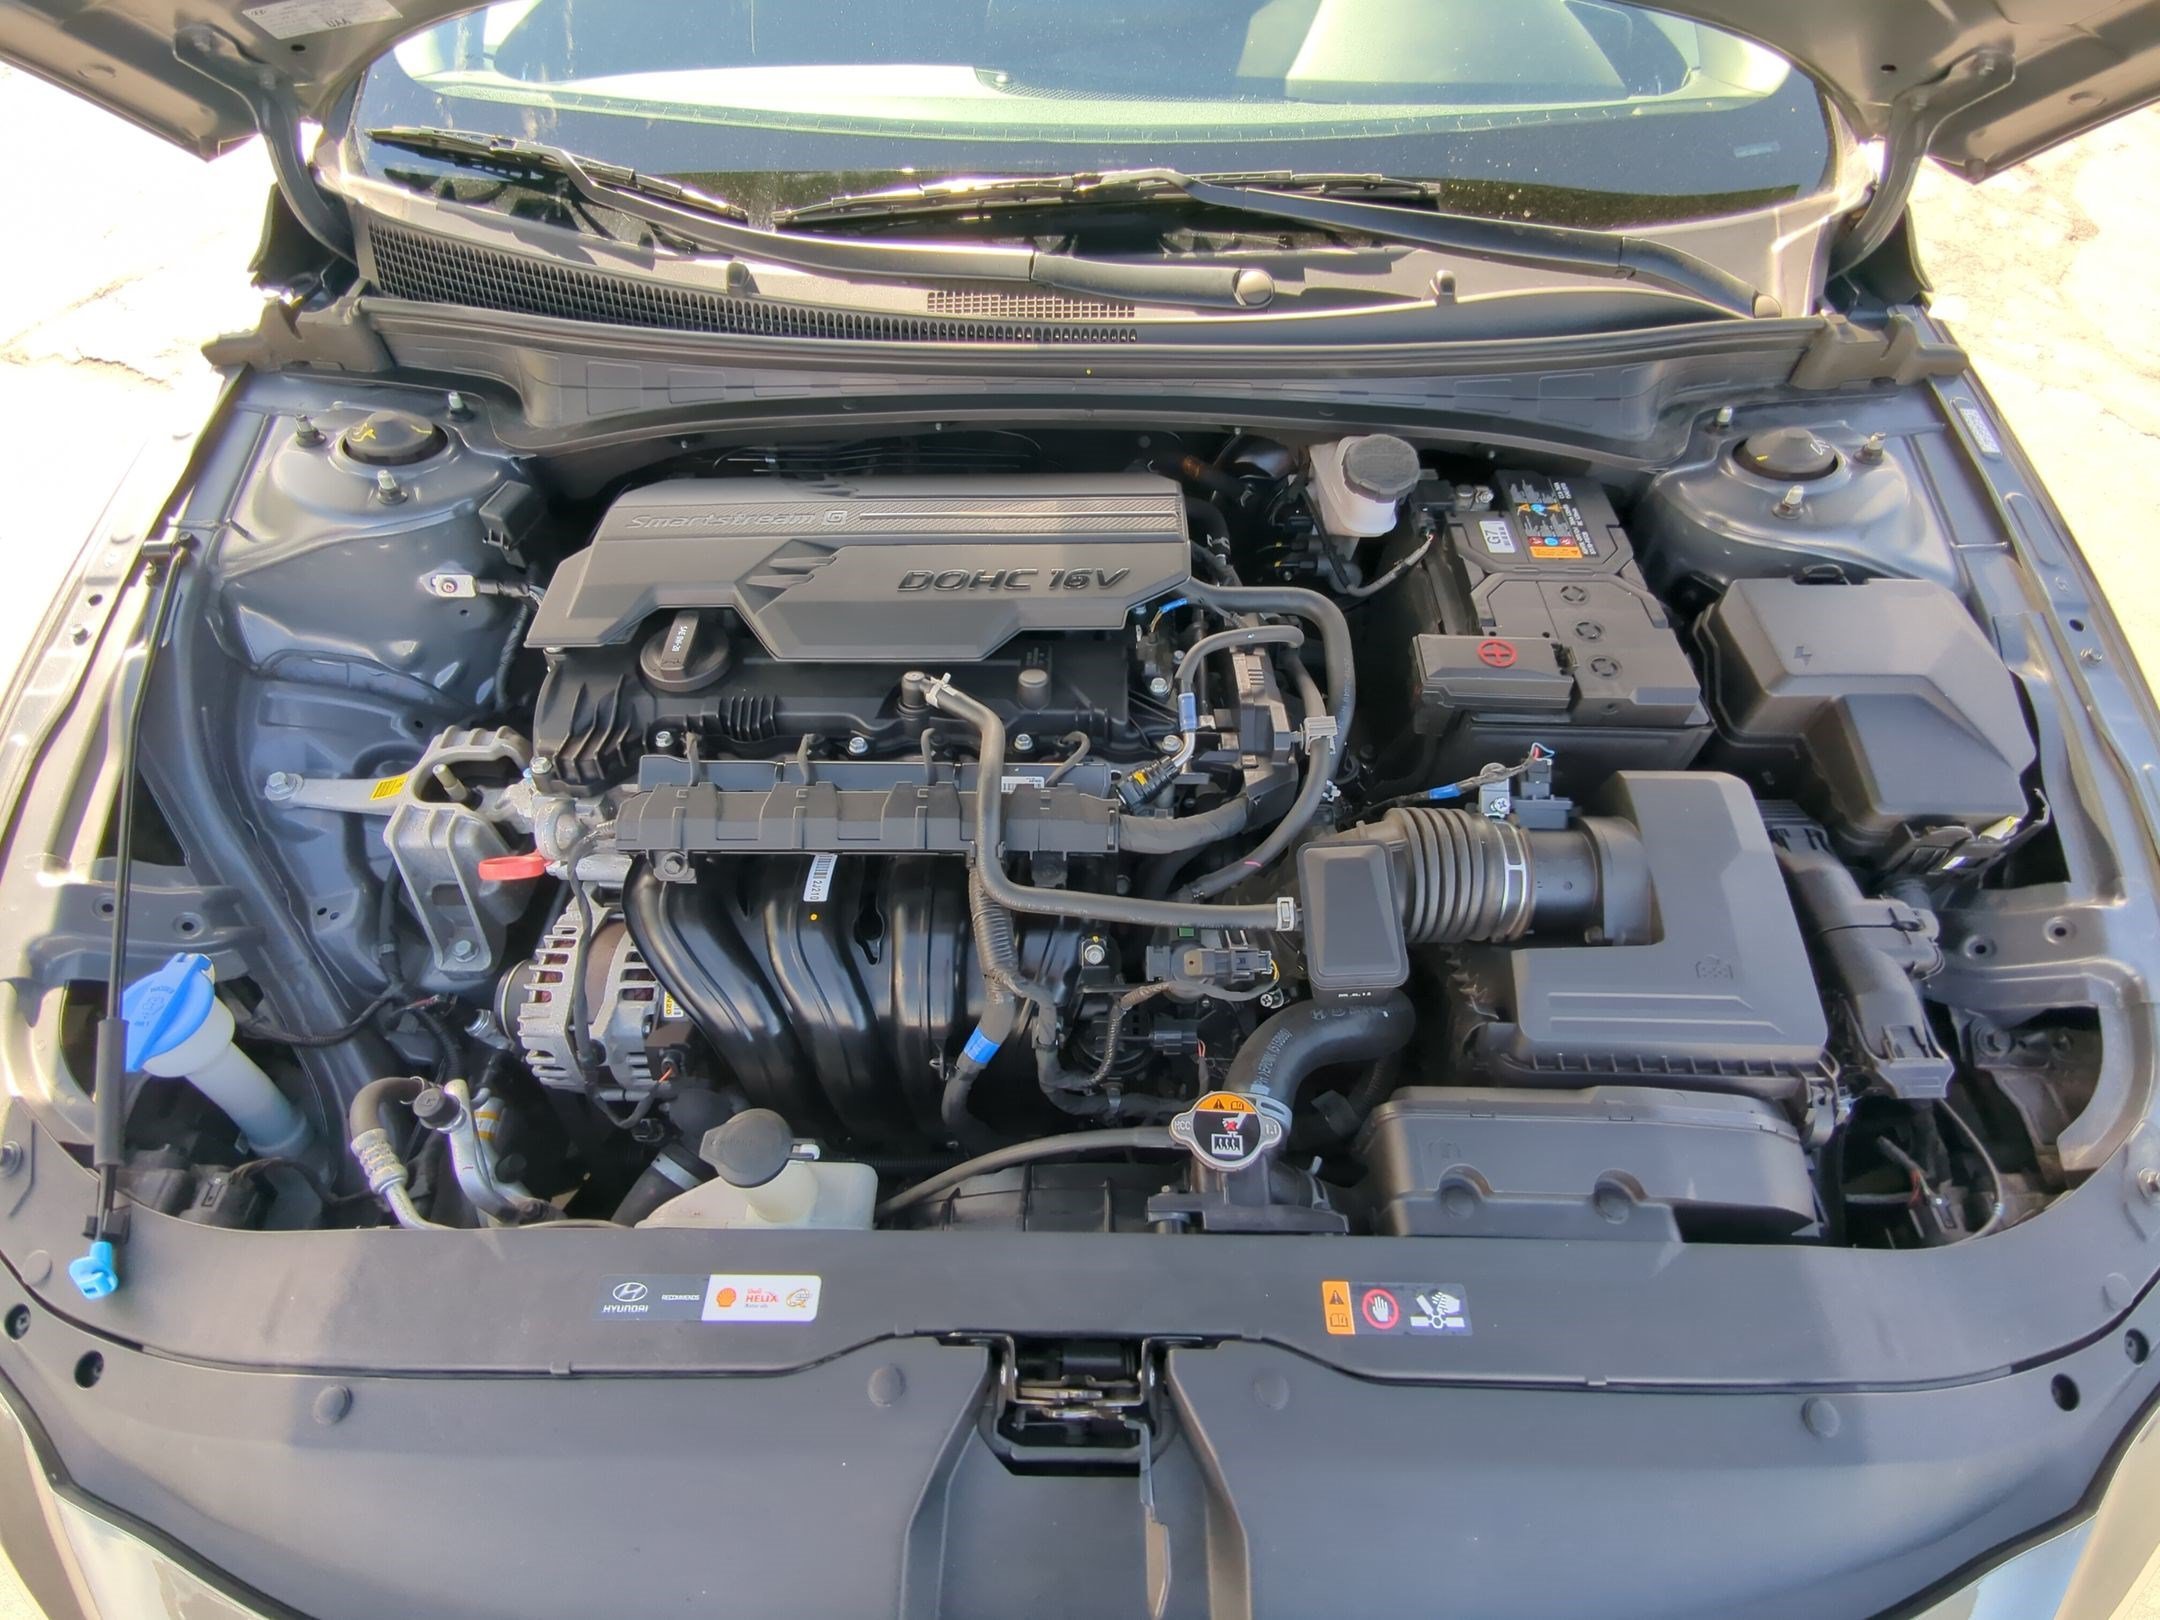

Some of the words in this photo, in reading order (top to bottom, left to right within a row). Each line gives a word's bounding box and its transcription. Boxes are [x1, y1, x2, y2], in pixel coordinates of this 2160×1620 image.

[626, 514, 816, 529] Smartstream
[822, 510, 848, 526] G
[897, 569, 1039, 592] DOHC
[1049, 568, 1131, 591] 16V
[745, 1293, 778, 1303] HELIX
[602, 1304, 650, 1313] HYUNDAI
